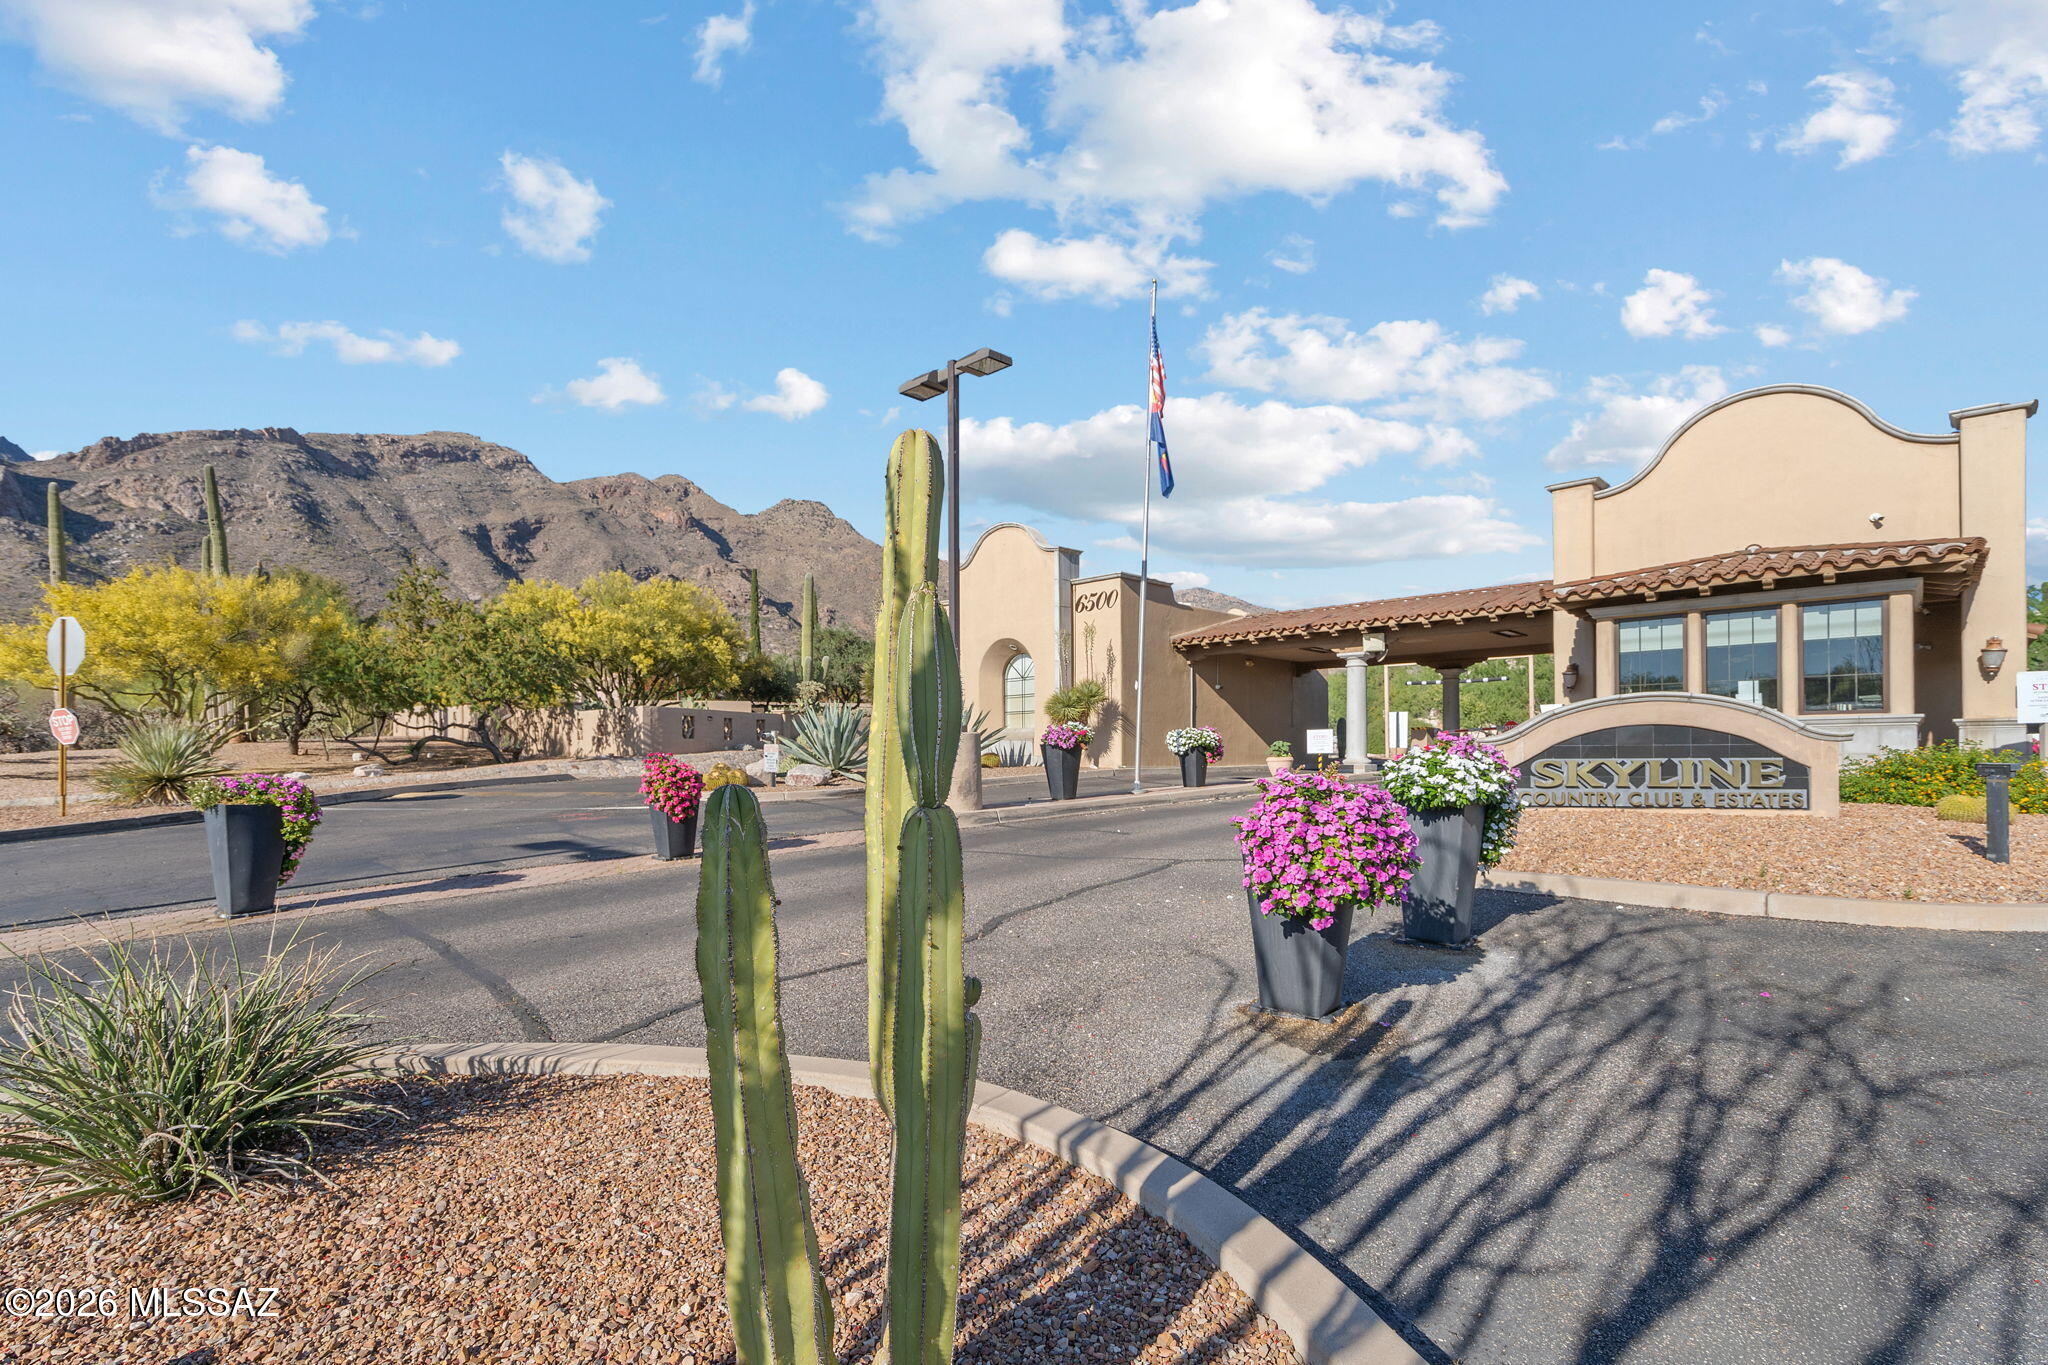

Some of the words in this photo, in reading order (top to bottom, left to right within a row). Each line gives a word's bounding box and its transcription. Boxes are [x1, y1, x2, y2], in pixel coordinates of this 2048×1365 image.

[1075, 589, 1119, 613] 6500
[52, 715, 74, 727] STOP
[1532, 758, 1786, 788] SKYLINE
[1519, 791, 1621, 806] COUNTRY
[1627, 791, 1684, 807] CLUB
[1691, 792, 1706, 807] &
[1714, 792, 1805, 808] ESTATES
